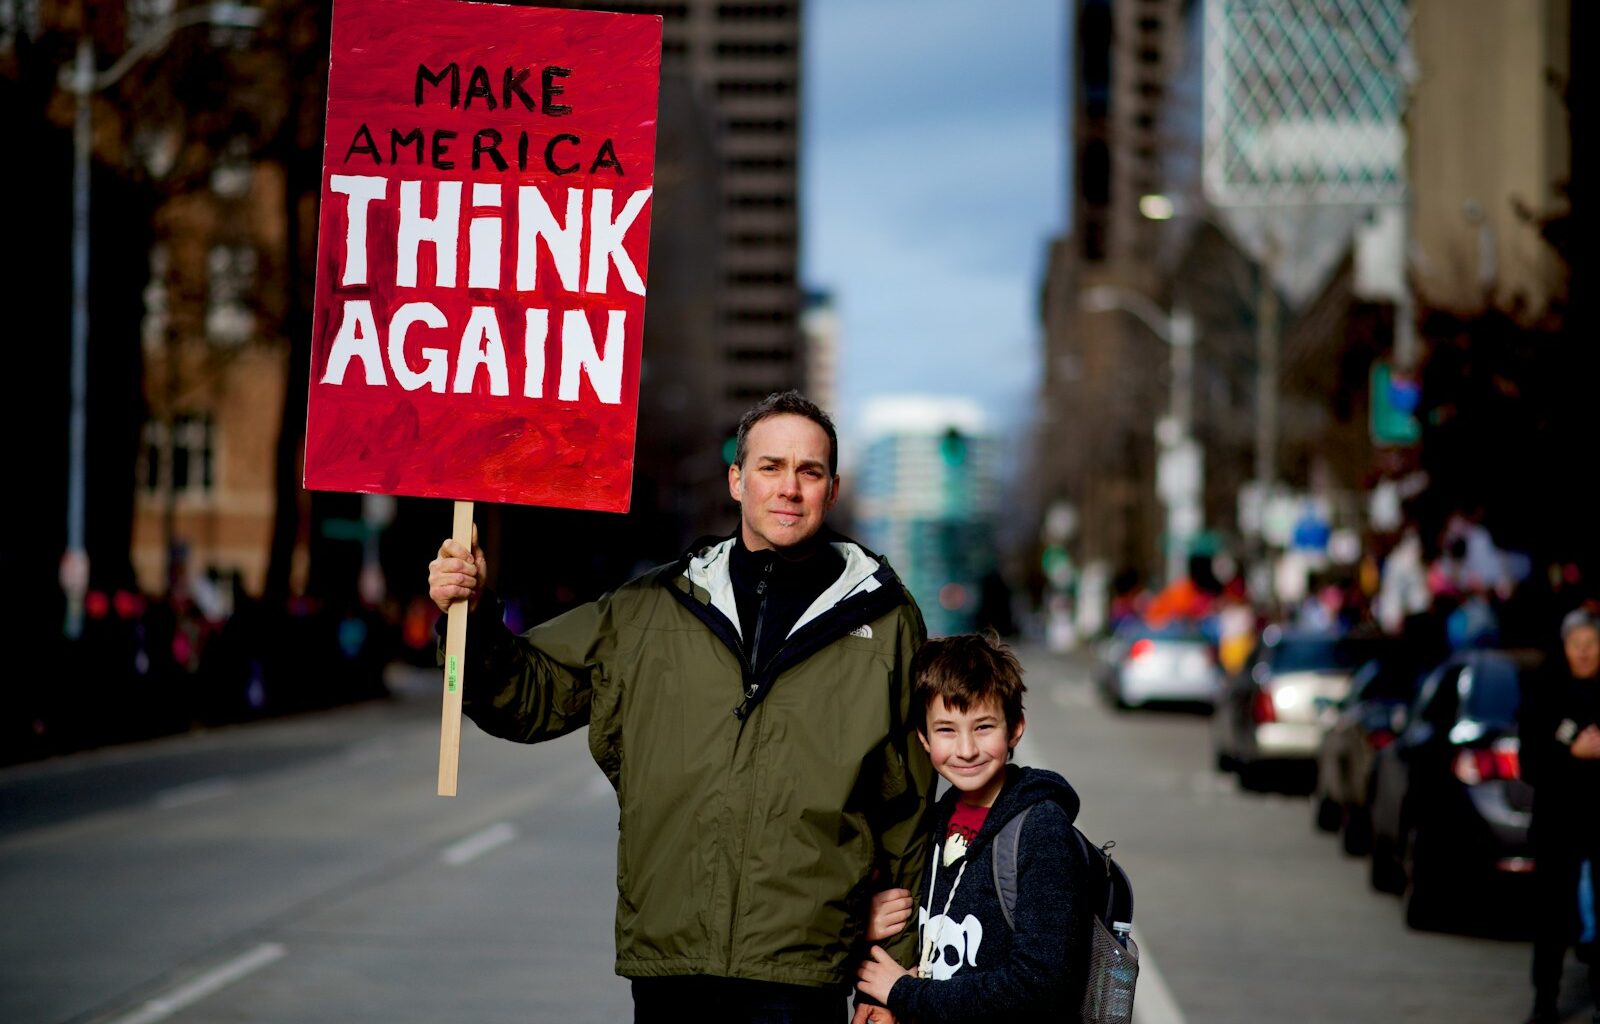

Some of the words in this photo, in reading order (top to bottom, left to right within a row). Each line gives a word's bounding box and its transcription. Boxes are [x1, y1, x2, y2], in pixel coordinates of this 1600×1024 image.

[415, 63, 573, 115] MAKE
[345, 124, 624, 176] AMERICA
[320, 299, 627, 404] AGAIN
